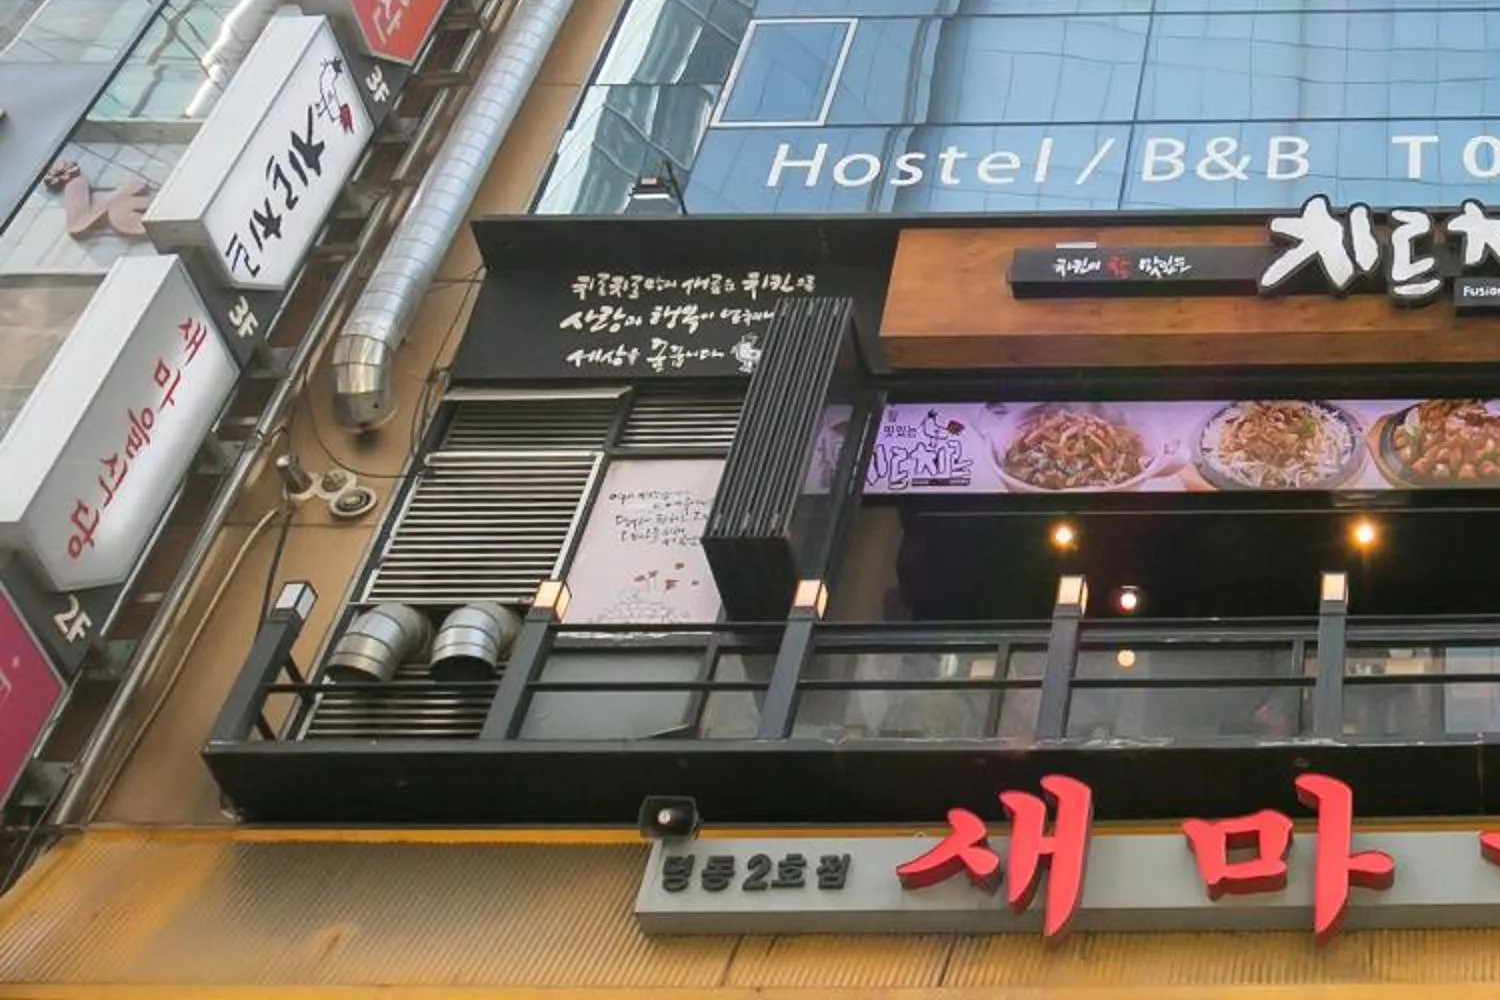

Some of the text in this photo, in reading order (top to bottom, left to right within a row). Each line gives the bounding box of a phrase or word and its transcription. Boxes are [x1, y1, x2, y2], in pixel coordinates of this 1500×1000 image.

[365, 64, 391, 104] 3F
[766, 136, 1053, 188] Hostel
[1140, 135, 1312, 183] B&B
[1391, 134, 1440, 179] T
[228, 294, 260, 341] 3F
[66, 315, 209, 562] 새마을식당
[53, 594, 92, 645] 2F
[661, 852, 851, 893] 명동2호점
